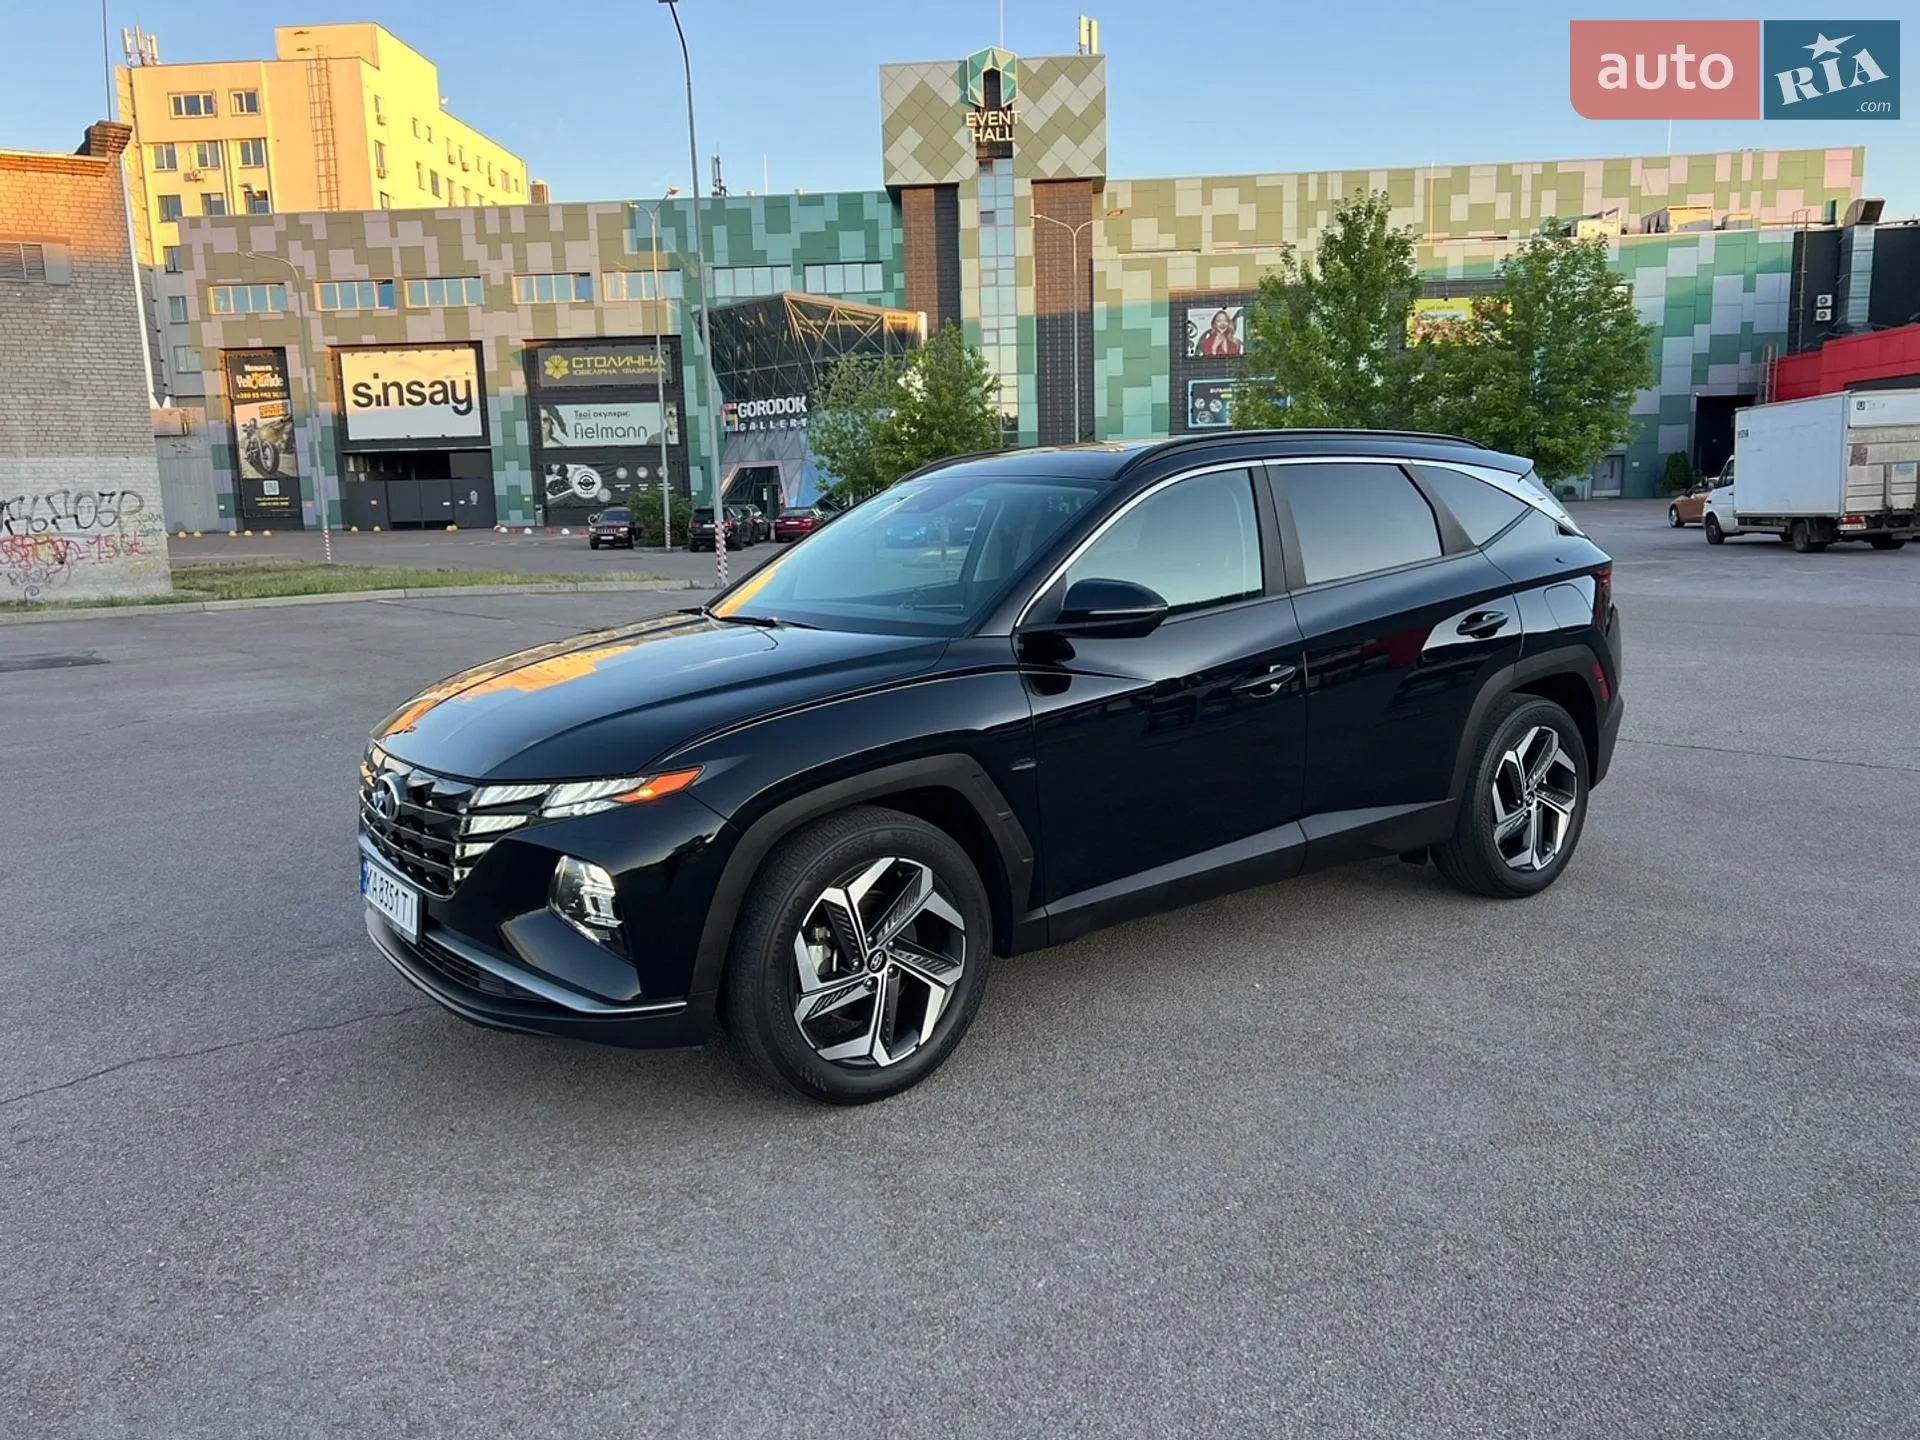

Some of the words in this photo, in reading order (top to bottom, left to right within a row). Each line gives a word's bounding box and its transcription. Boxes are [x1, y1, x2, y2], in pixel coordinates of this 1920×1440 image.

[966, 110, 1021, 127] EVENT
[972, 125, 1016, 142] HALL
[572, 355, 666, 368] СТОЛИЧНА
[352, 372, 473, 416] sinsay
[738, 395, 808, 419] GORODOK
[739, 417, 808, 432] GALLERY
